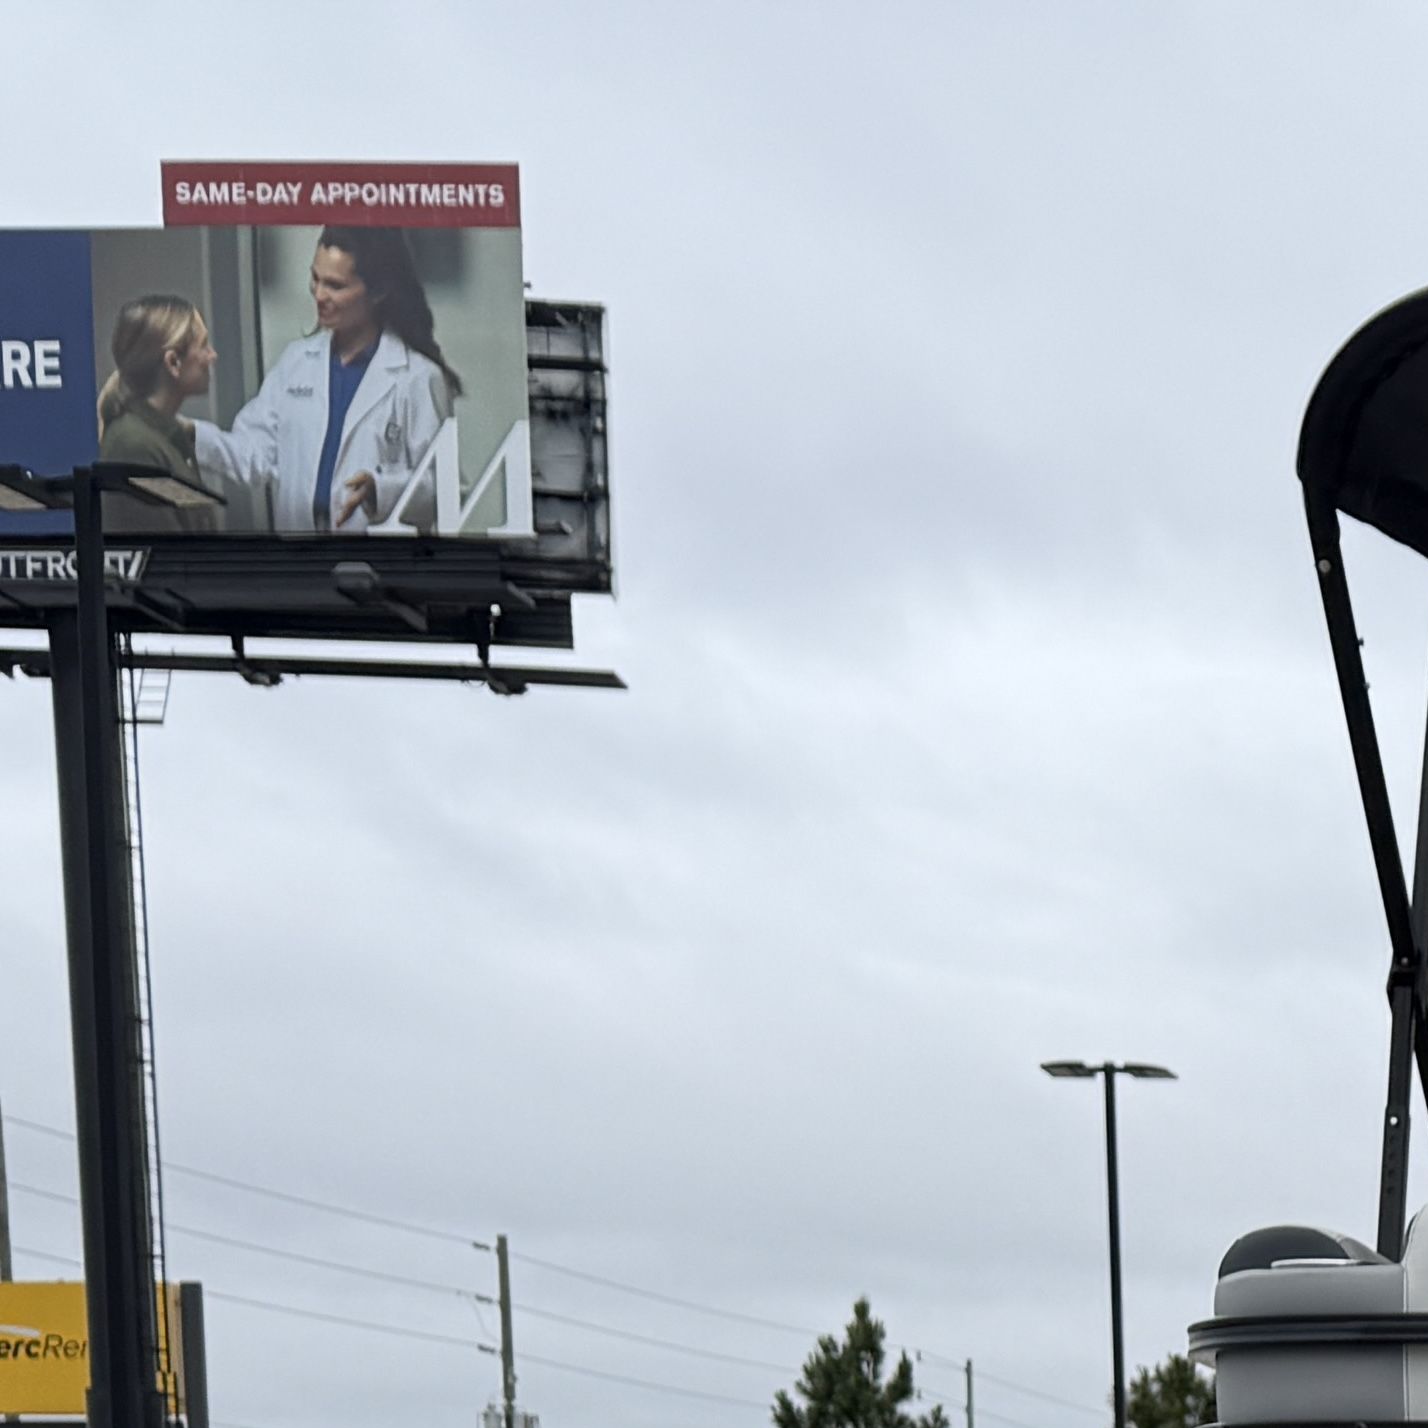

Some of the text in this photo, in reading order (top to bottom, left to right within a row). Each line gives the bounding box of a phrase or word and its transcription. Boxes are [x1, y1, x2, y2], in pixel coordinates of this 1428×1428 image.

[175, 181, 505, 208] SAME-DAY APPOINTMENTS
[1, 339, 63, 390] RE
